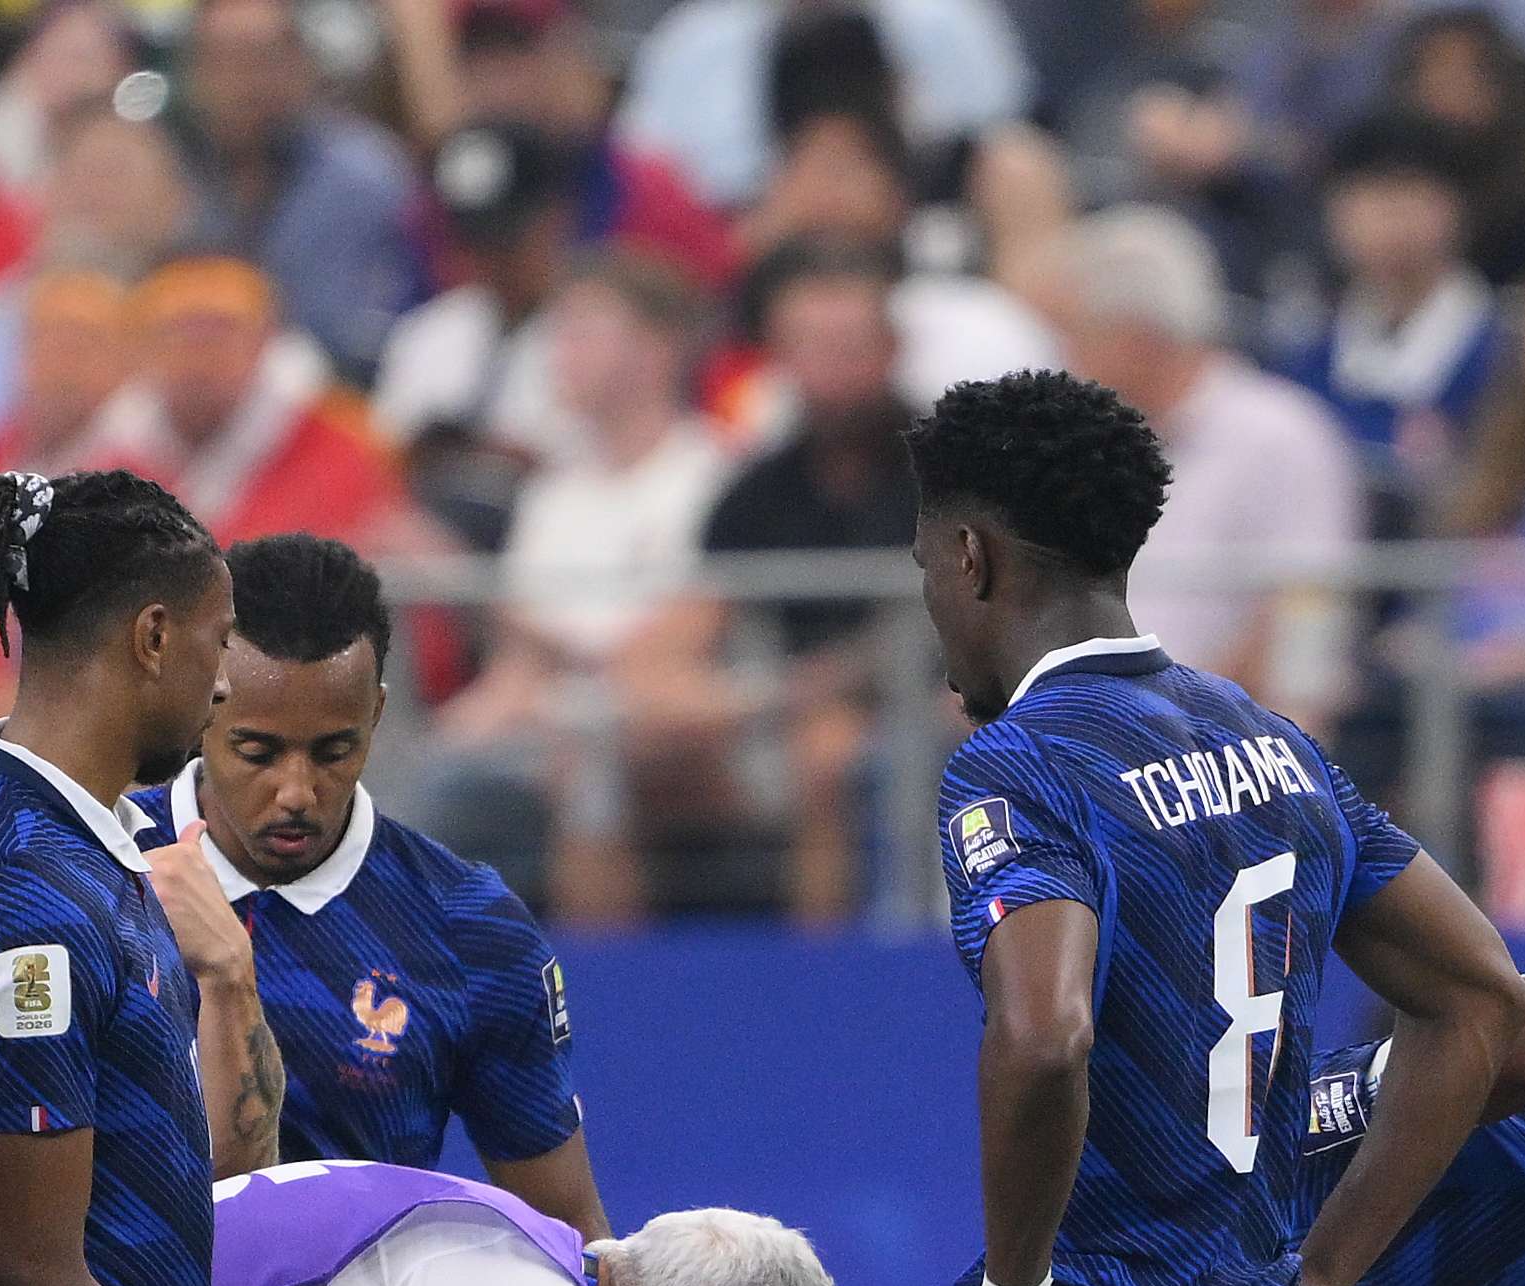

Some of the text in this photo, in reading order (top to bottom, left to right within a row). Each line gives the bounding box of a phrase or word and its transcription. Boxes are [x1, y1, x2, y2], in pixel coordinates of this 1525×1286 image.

[965, 838, 1009, 874] EDUCATION
[16, 1021, 53, 1030] 2026
[1330, 1082, 1352, 1133] EDUCATION
